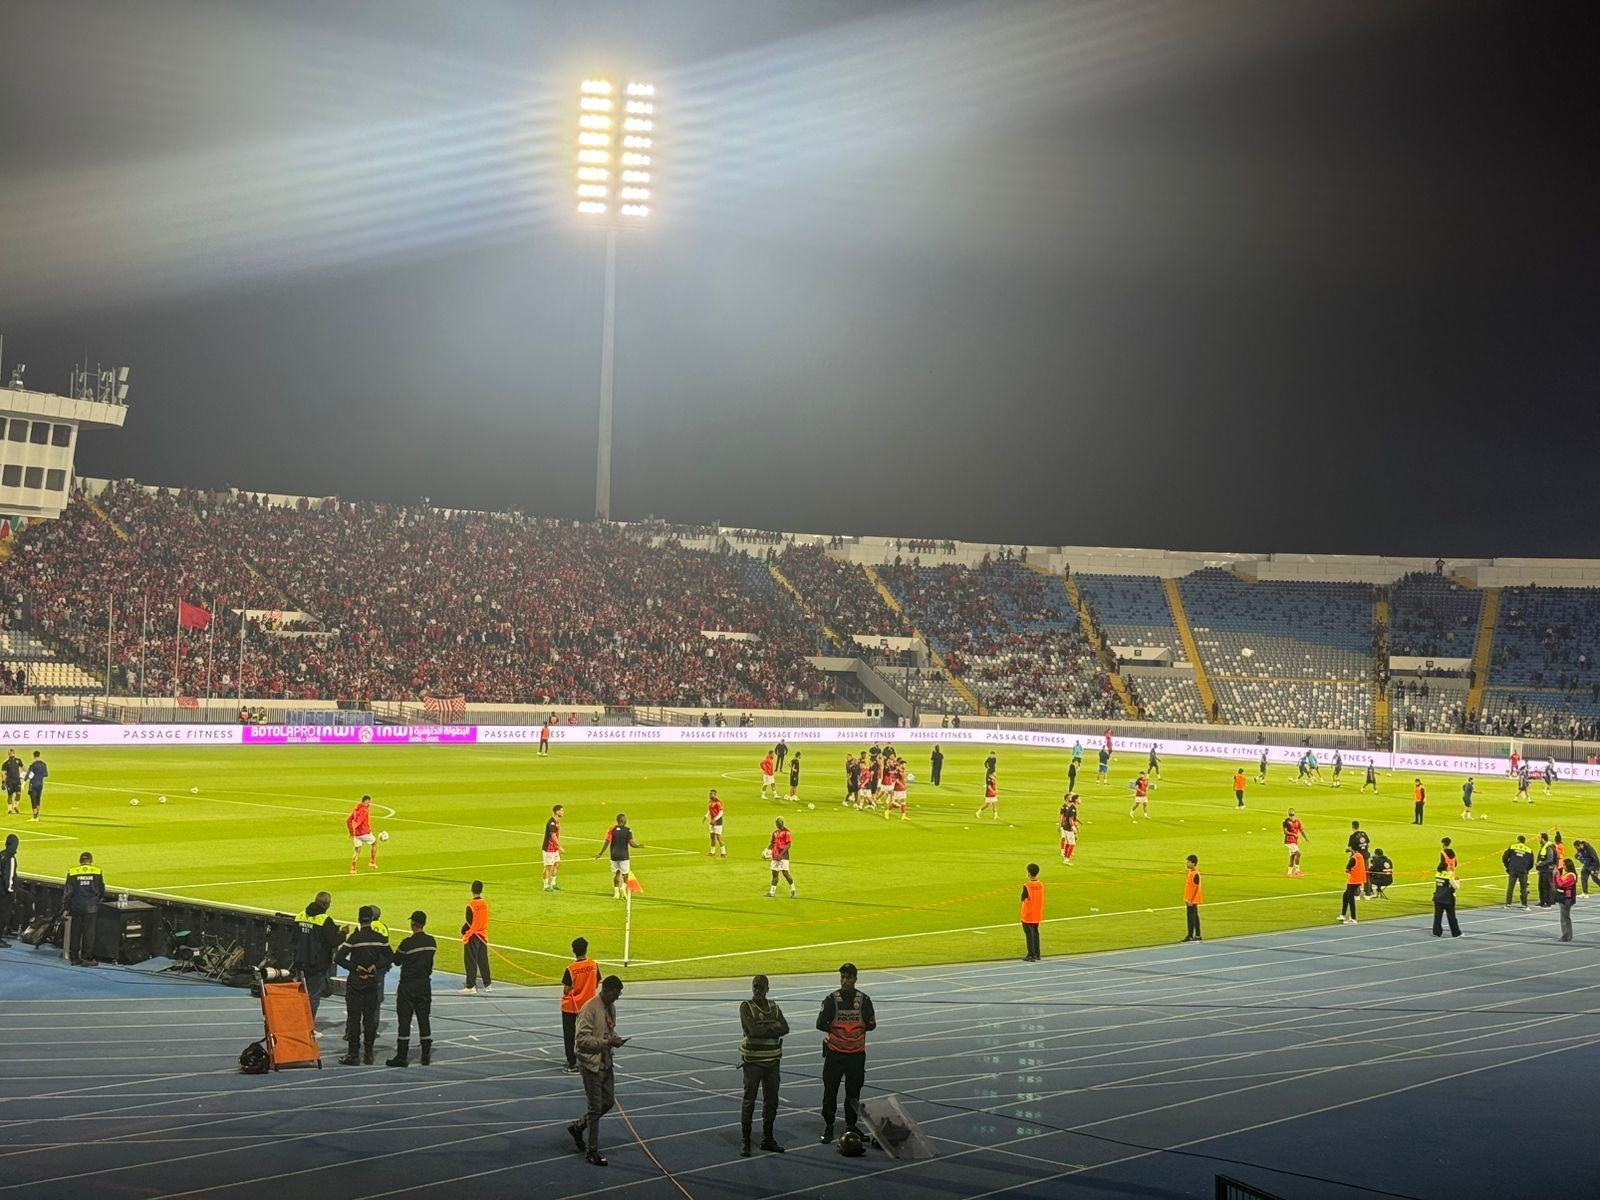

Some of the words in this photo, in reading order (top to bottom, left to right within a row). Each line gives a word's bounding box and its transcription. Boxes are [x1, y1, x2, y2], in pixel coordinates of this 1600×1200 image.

[37, 730, 89, 739] FITNESS
[123, 730, 181, 739] PASSAGE
[187, 730, 233, 739] FITNESS
[484, 730, 527, 739] PASSAGE
[587, 730, 627, 738] PASSAGE
[629, 730, 661, 738] FITNESS
[837, 731, 868, 739] PASSAGE
[870, 731, 896, 739] FITNESS
[910, 731, 938, 739] PASSAGE
[940, 731, 972, 739] FITNESS
[986, 733, 1029, 742] PASSAGE
[1032, 735, 1065, 744] FITNESS
[1186, 745, 1228, 754] PASSAGE
[1399, 758, 1449, 768] PASSAGE
[1453, 760, 1497, 770] FITNESS
